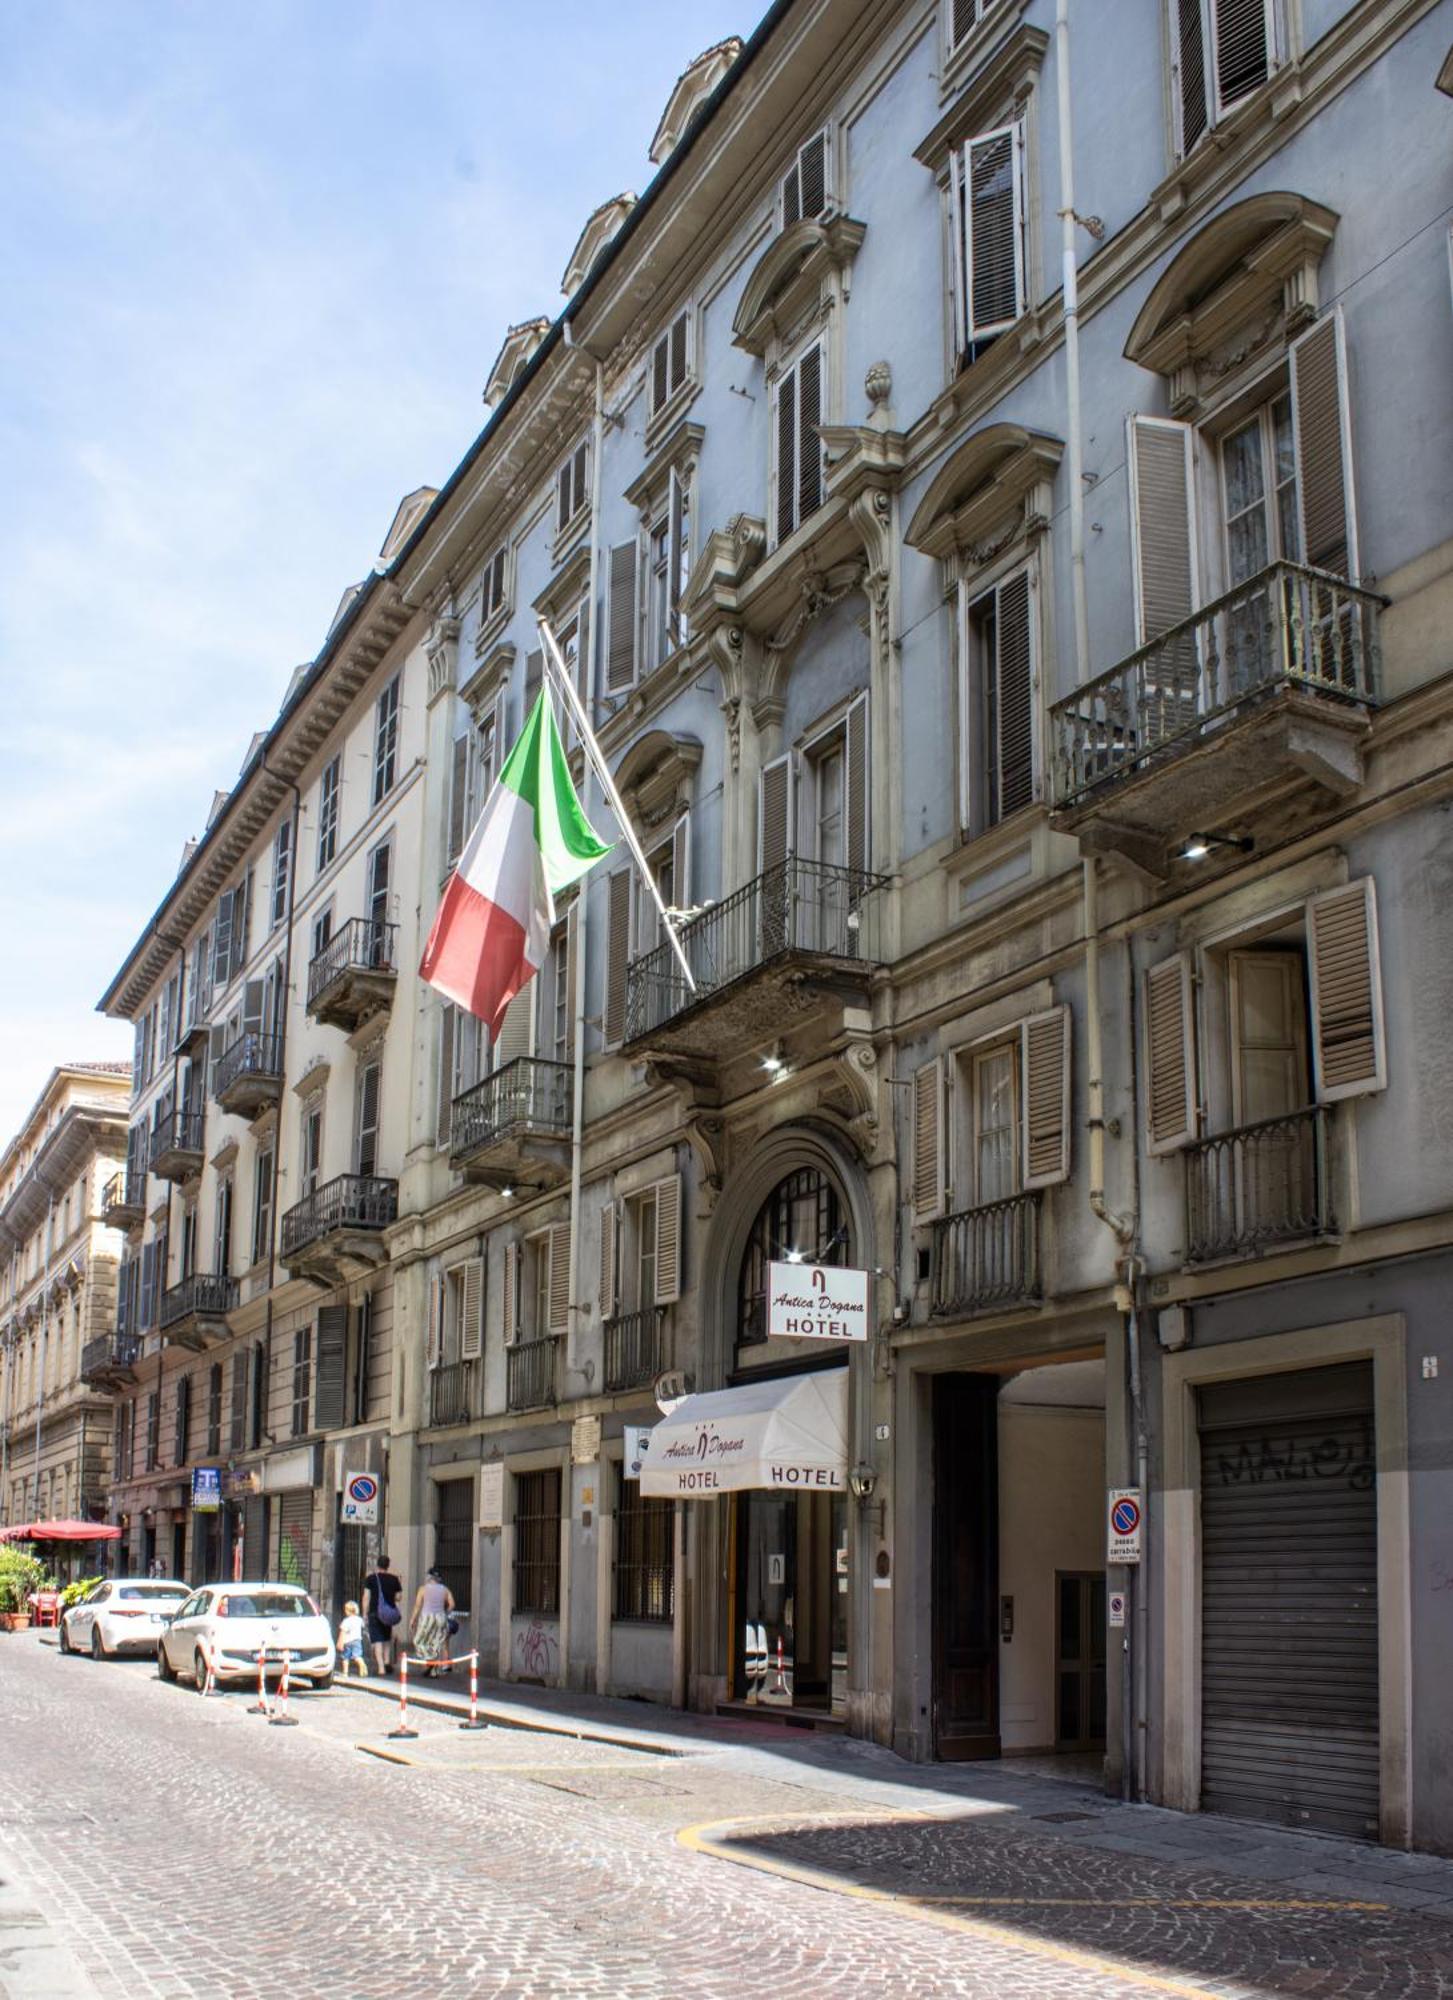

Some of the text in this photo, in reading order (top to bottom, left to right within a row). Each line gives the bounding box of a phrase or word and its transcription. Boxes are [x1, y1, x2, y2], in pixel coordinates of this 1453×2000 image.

[773, 1293, 865, 1315] Antica Dogana
[786, 1318, 852, 1336] HOTEL
[662, 1435, 744, 1460] Antica Dogana
[679, 1471, 719, 1489] HOTEL
[771, 1466, 840, 1486] HOTEL
